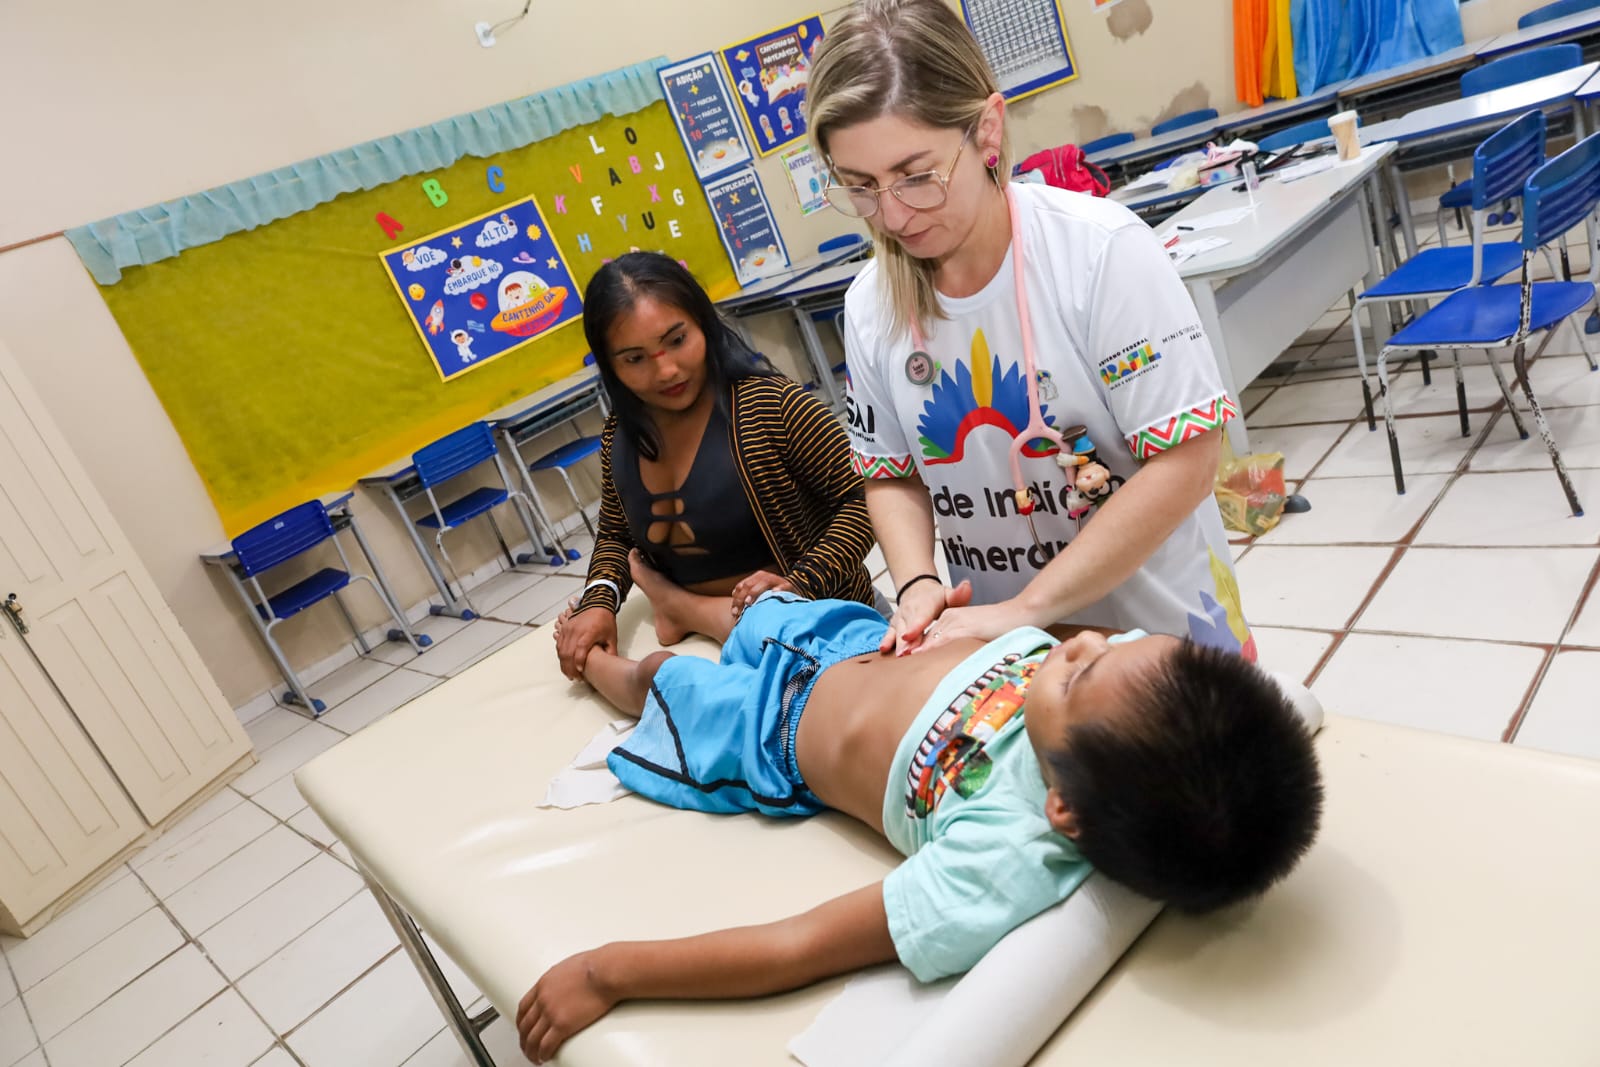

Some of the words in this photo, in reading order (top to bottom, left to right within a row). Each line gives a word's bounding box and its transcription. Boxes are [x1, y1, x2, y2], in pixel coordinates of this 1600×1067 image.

[676, 69, 704, 87] ADIÇÃO
[682, 102, 689, 112] 7
[687, 115, 695, 126] 3
[625, 127, 637, 144] O
[690, 128, 702, 142] 10
[589, 136, 605, 155] L
[628, 155, 642, 174] B
[654, 152, 664, 170] J
[569, 164, 582, 184] V
[608, 167, 622, 186] A
[648, 184, 662, 203] X
[710, 174, 754, 199] MULTIPLICAÇÃO
[375, 211, 404, 240] A
[422, 178, 449, 208] B
[487, 165, 506, 193] C
[554, 195, 567, 214] K
[590, 196, 603, 216] F
[672, 188, 685, 206] G
[617, 214, 627, 232] Y
[642, 211, 655, 230] U
[668, 219, 682, 239] E
[482, 224, 509, 242] ALTO
[577, 233, 593, 253] H
[416, 251, 436, 265] VOE
[447, 270, 485, 292] EMBARQUE
[486, 264, 500, 277] NO
[502, 300, 545, 322] CANTINHO
[544, 293, 556, 303] DA
[1122, 338, 1149, 354] FEDERAL
